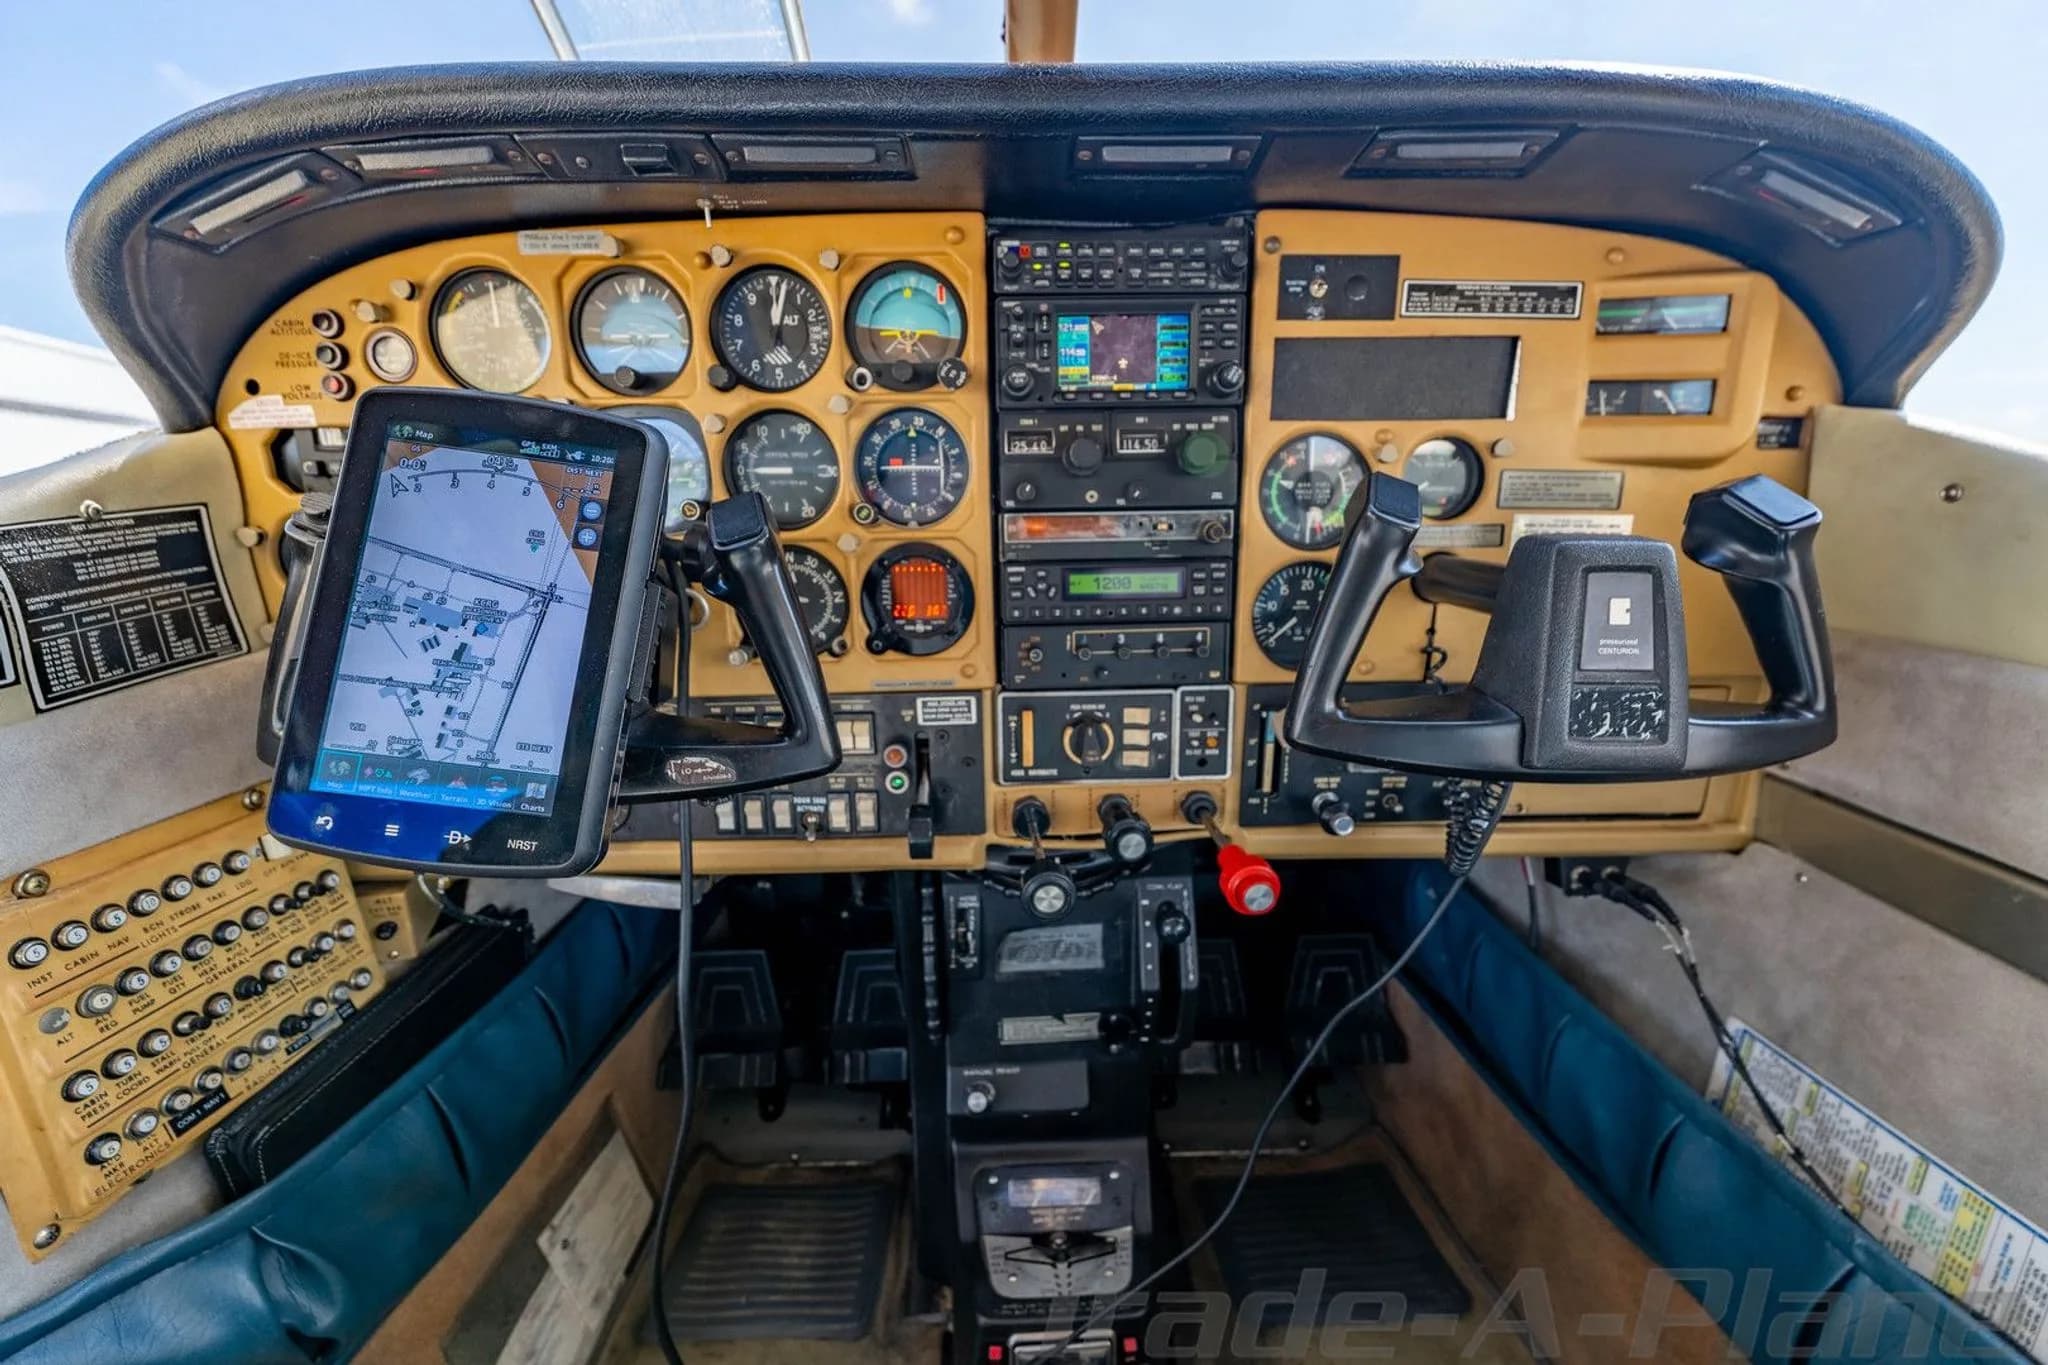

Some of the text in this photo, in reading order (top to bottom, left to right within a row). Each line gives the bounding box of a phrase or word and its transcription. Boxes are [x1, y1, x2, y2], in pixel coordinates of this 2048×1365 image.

[748, 293, 757, 305] 9
[734, 314, 743, 326] 8
[783, 315, 799, 325] ALT
[808, 309, 816, 321] 2
[734, 339, 743, 351] 7
[810, 343, 818, 355] 3
[752, 359, 760, 372] 6
[775, 368, 784, 380] 5
[415, 430, 434, 440] Map
[757, 424, 769, 436] 10
[556, 499, 565, 509] 6
[805, 555, 818, 567] 30
[1301, 580, 1314, 591] 20
[1267, 600, 1278, 612] 10
[1598, 646, 1640, 655] CENTURION
[400, 789, 432, 799] Weather
[440, 794, 468, 803] Terrain
[488, 799, 512, 809] Vision
[520, 802, 545, 813] Charts
[507, 839, 539, 851] NRST
[140, 926, 177, 948] LIGHTS
[27, 971, 54, 989] INST
[64, 951, 100, 971] CABIN
[107, 936, 130, 951] NAV
[142, 919, 165, 934] BCN
[169, 903, 201, 921] STROBE
[205, 958, 249, 985] GENERAL
[162, 974, 183, 988] FUEL
[168, 983, 186, 995] QTY
[128, 992, 149, 1006] FUEL
[132, 998, 156, 1015] PUMP
[98, 1020, 119, 1034] REG
[56, 1031, 75, 1047] ALT
[151, 1051, 176, 1067] STALL
[183, 1039, 225, 1069] GENERAL
[154, 1057, 181, 1075] WARN
[115, 1071, 142, 1089] TURN
[116, 1076, 151, 1100] COORD
[74, 1091, 109, 1116] CABIN
[80, 1101, 111, 1122] PRESS
[177, 1113, 196, 1129] COM
[94, 1141, 171, 1196] ELECTRONICS
